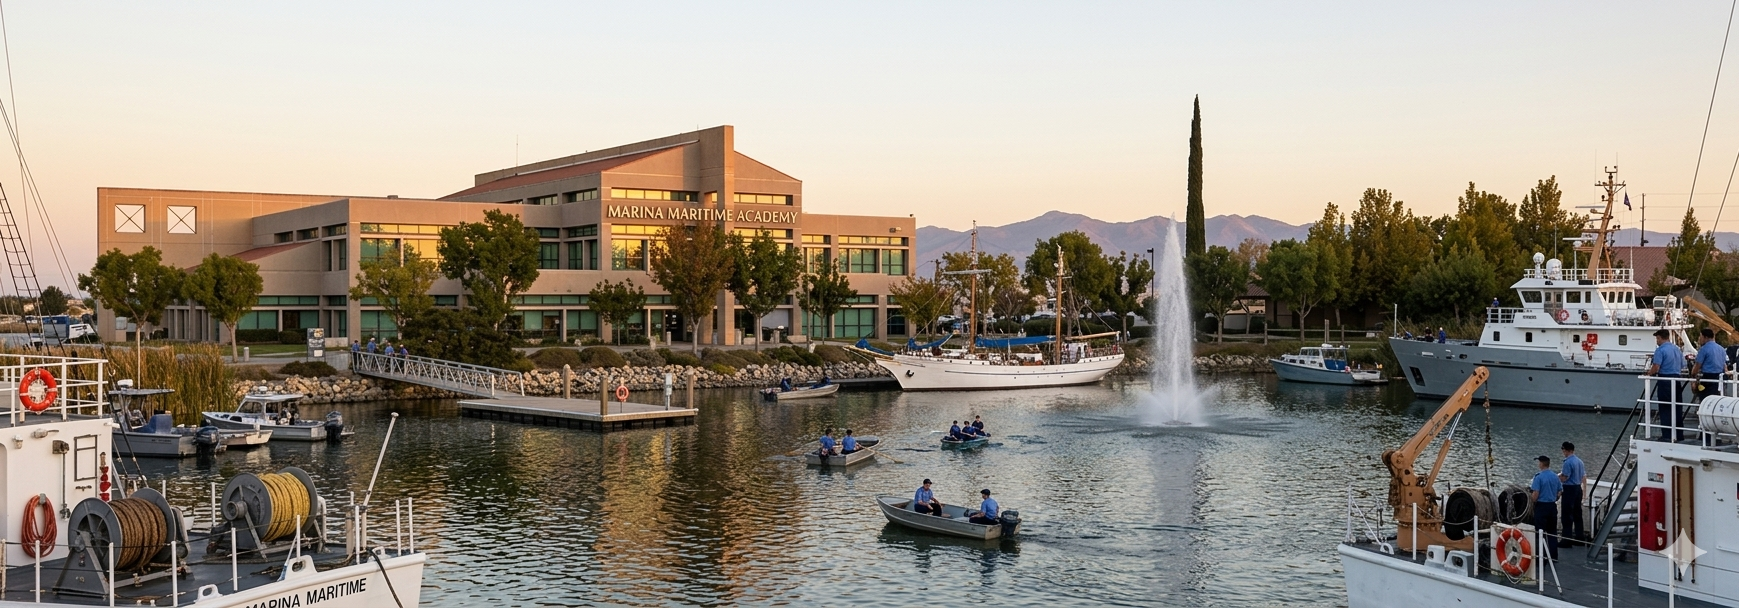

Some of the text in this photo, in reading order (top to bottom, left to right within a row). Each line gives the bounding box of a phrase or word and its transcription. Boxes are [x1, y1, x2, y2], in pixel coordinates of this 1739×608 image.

[608, 205, 798, 224] MARINA MARITIME ACADEMY
[246, 577, 367, 608] RINA MARITIME
